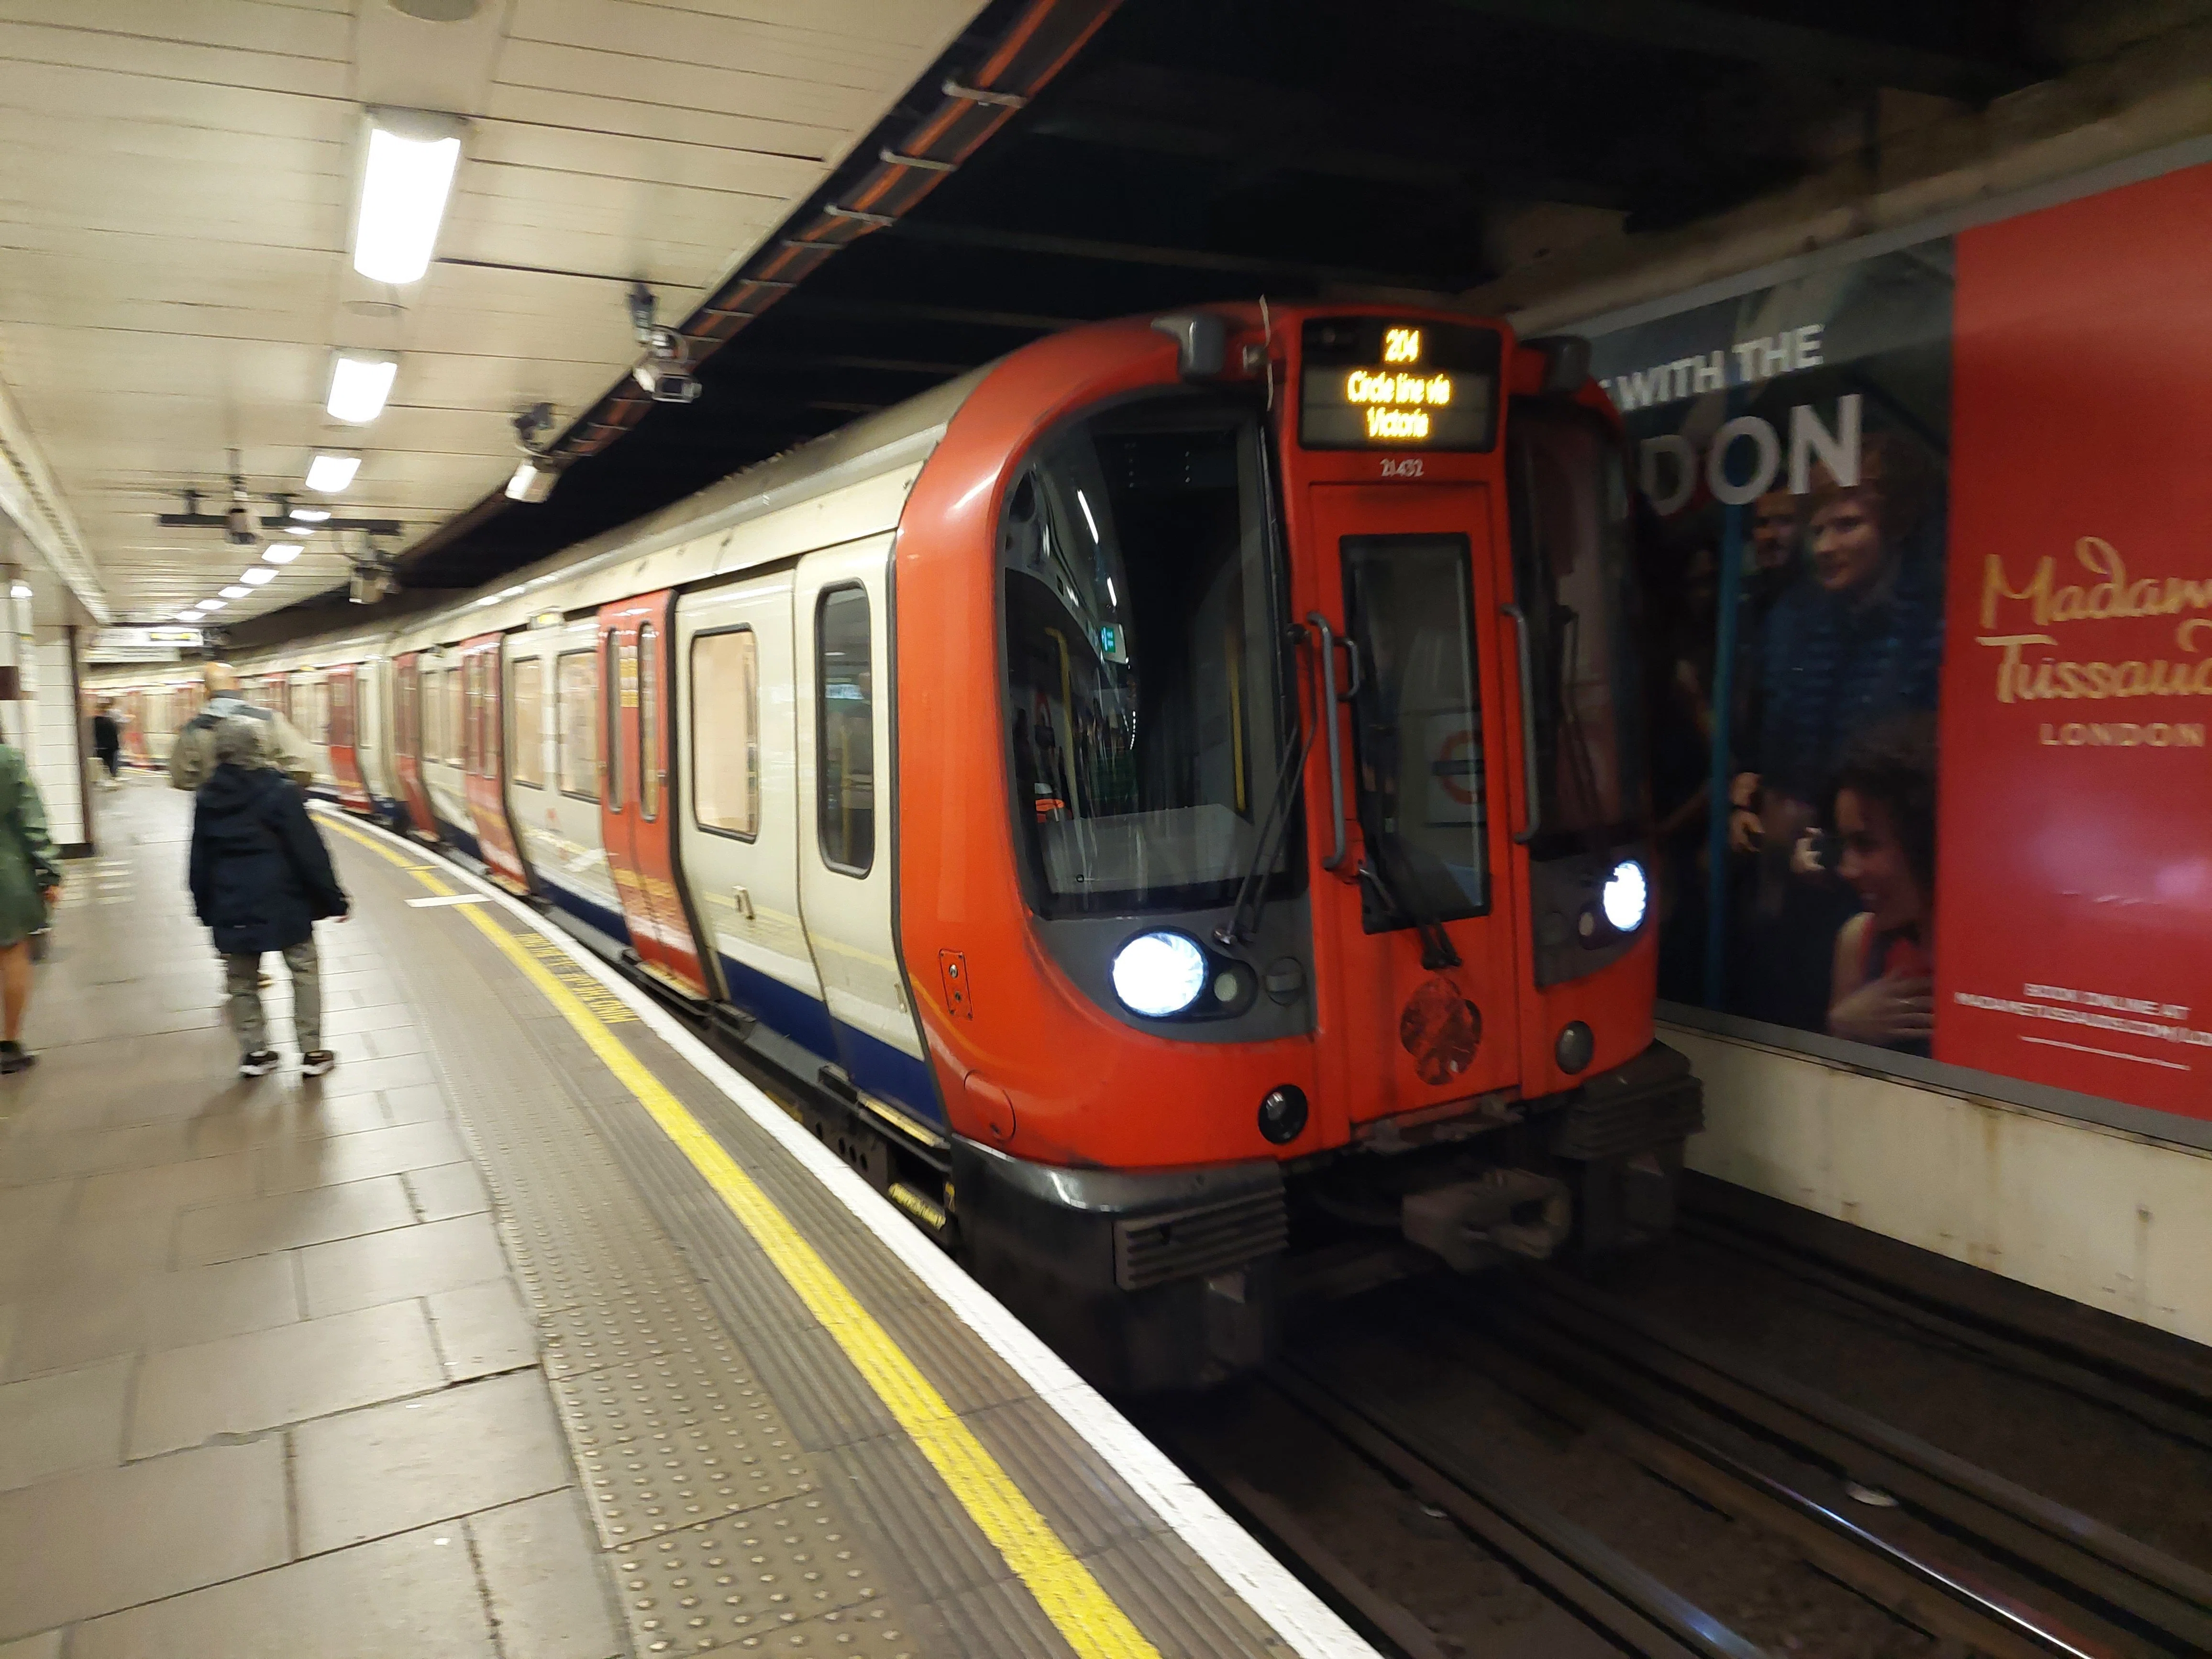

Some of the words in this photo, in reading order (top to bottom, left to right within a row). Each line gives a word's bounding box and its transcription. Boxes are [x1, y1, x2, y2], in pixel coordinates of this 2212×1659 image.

[1616, 350, 1724, 410] WITH
[1732, 323, 1825, 382] THE
[1347, 371, 1394, 403] Circle
[1426, 374, 1450, 405] via
[1367, 406, 1429, 438] Victoria
[2039, 723, 2206, 747] LONDON
